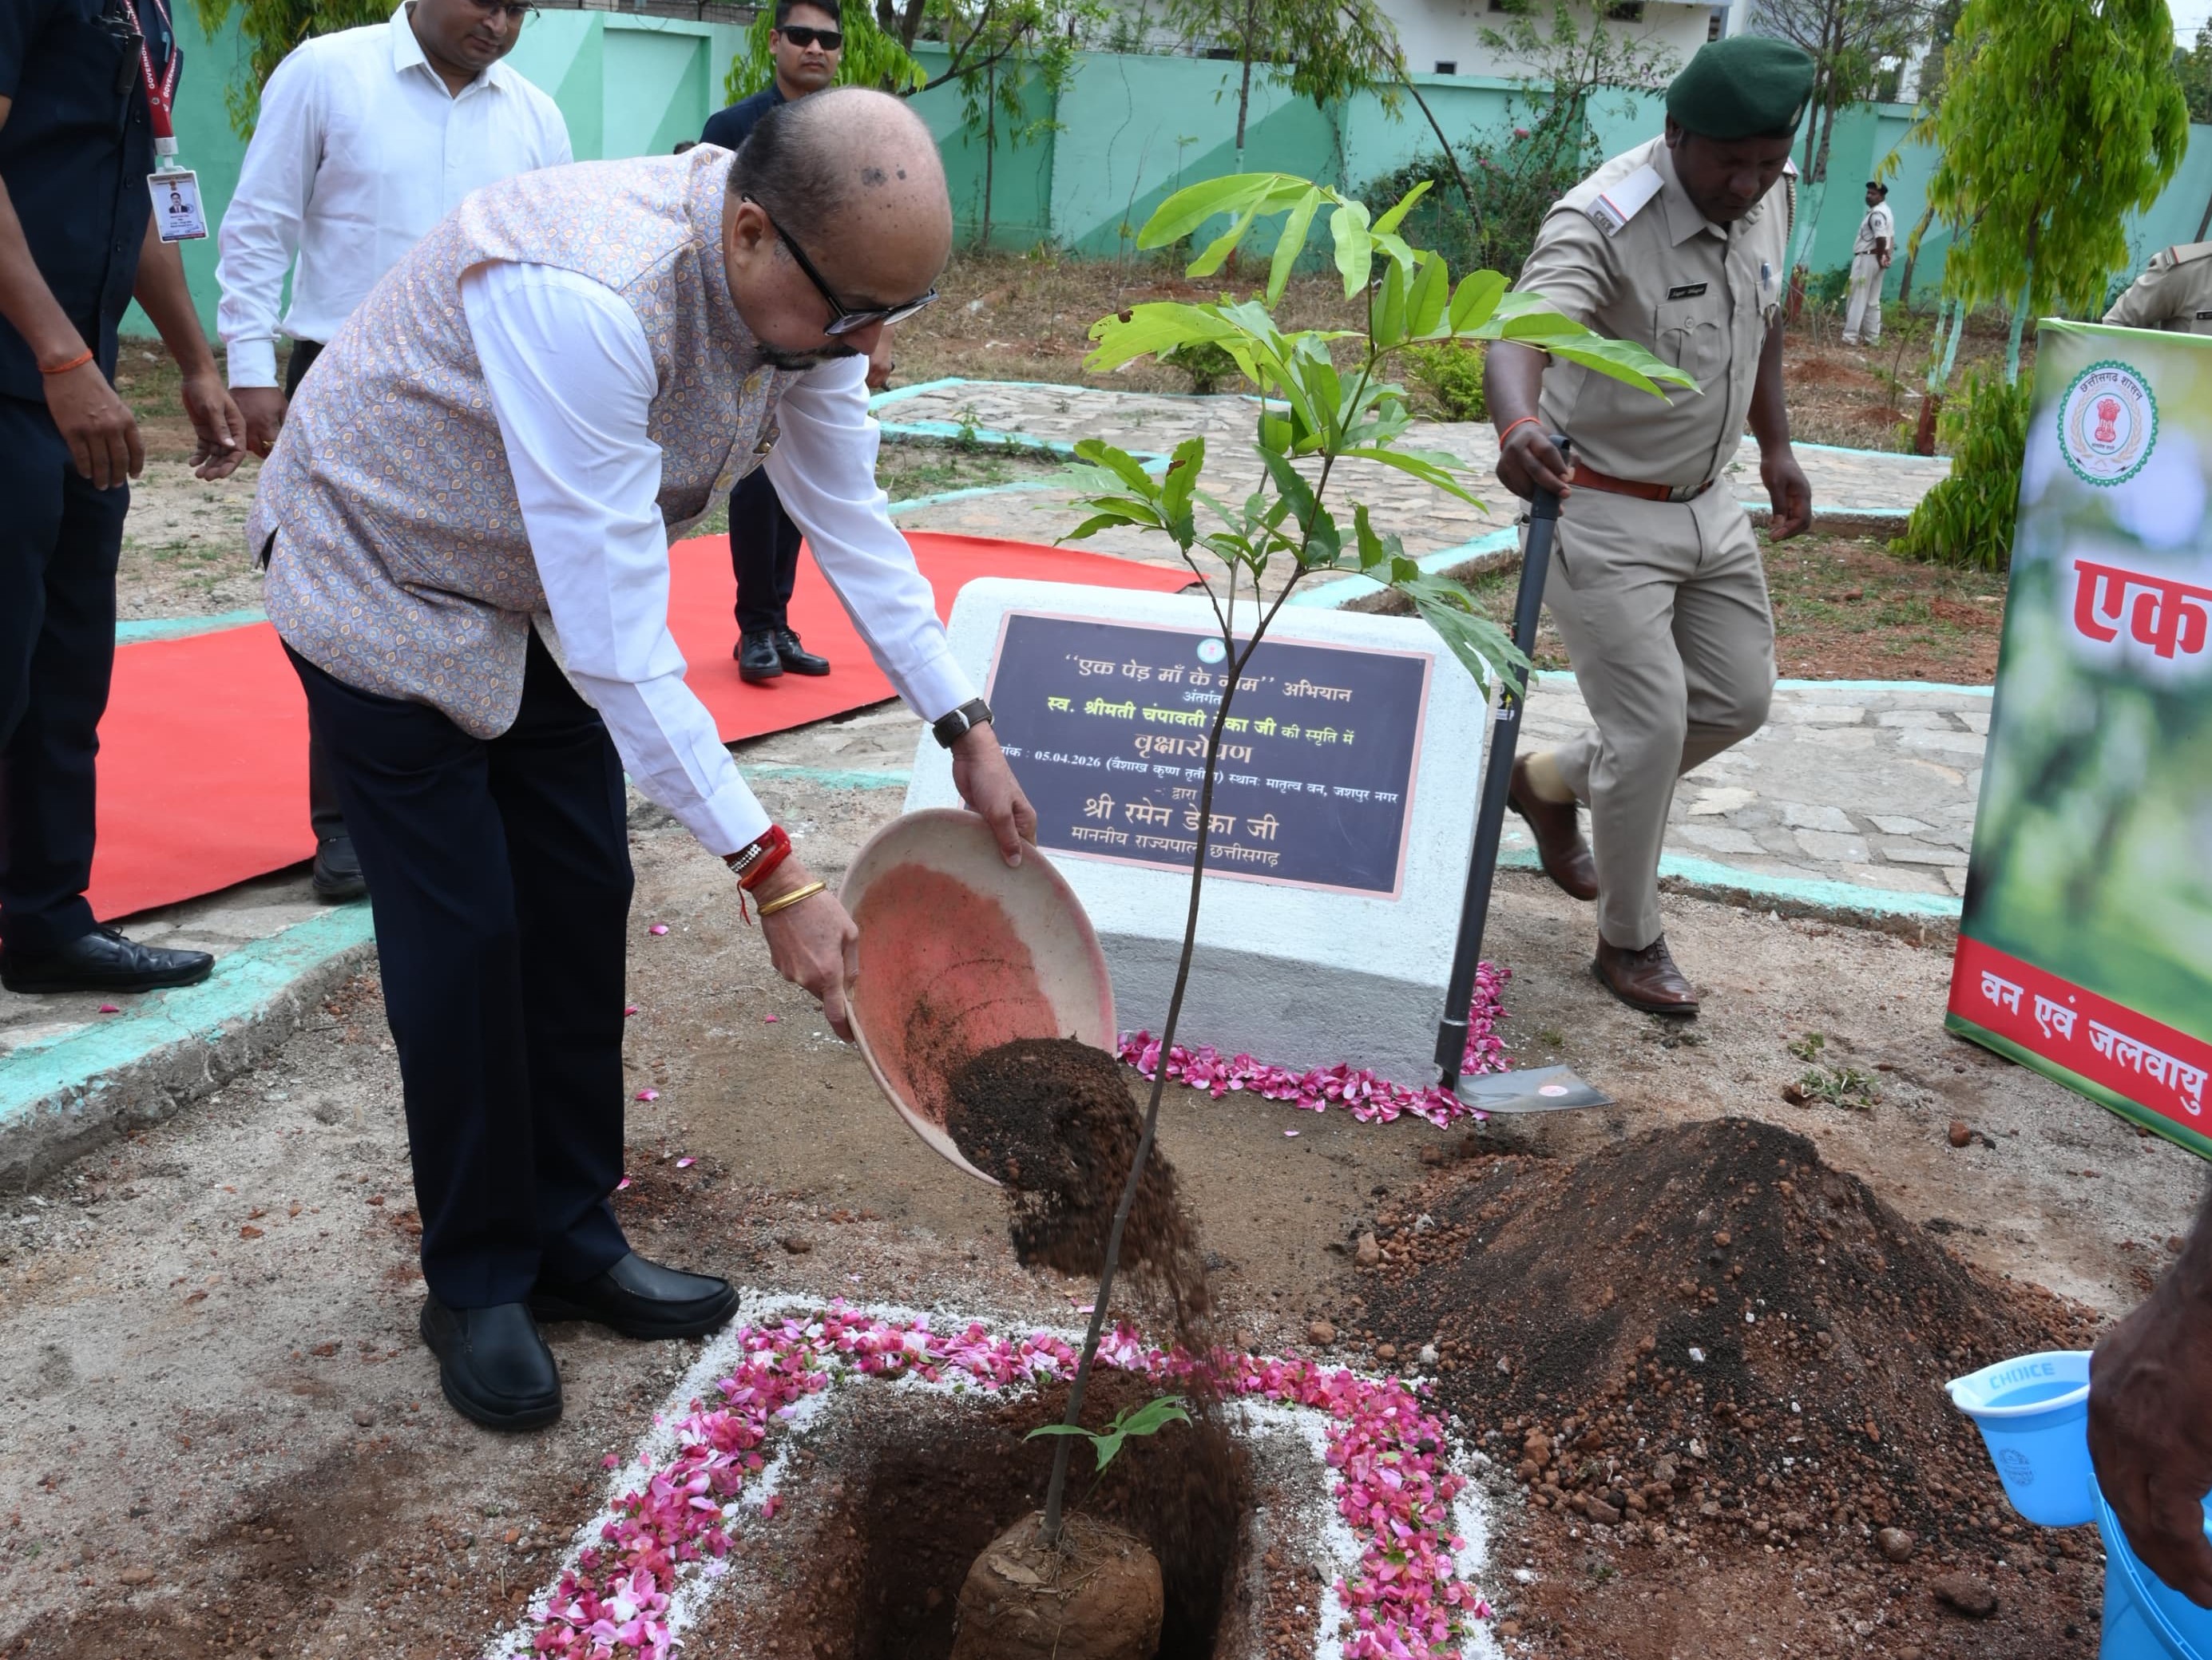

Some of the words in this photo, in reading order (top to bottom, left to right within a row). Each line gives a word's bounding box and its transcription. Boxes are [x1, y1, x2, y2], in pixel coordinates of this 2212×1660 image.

[2121, 376, 2143, 402] शासन
[2074, 559, 2212, 660] एक
[1122, 660, 1152, 682] पेड़
[1158, 664, 1185, 683] माँ
[1189, 667, 1212, 686] के
[1282, 679, 1353, 702] अभियान
[1183, 689, 1223, 705] अंतर्गत
[1047, 696, 1075, 713] स्व.
[1084, 698, 1136, 719] श्रीमती
[1142, 703, 1207, 728] चंपावती
[1254, 717, 1277, 736] जी
[1282, 724, 1300, 739] की
[1305, 727, 1338, 746] स्मृति
[1342, 729, 1355, 746] में
[1035, 751, 1101, 767] 05.04.2026
[1106, 756, 1148, 773] (वैशाख
[1152, 764, 1181, 778] कृष्ण
[1266, 778, 1302, 794] मातृत्व
[1306, 782, 1328, 798] वन,
[1333, 786, 1370, 802] जशपुर
[1374, 791, 1399, 804] नगर
[1171, 786, 1198, 800] द्वारा
[1083, 793, 1116, 820] श्री
[1125, 797, 1173, 827] रमेन
[1247, 813, 1280, 842] जी
[1071, 826, 1129, 846] माननीय
[1209, 843, 1281, 868] छत्तीसगढ़
[1980, 970, 2024, 1016] वन
[2034, 995, 2077, 1041] एवं
[2088, 1019, 2208, 1116] जलवायु
[1989, 1362, 2055, 1390] CHOICE
